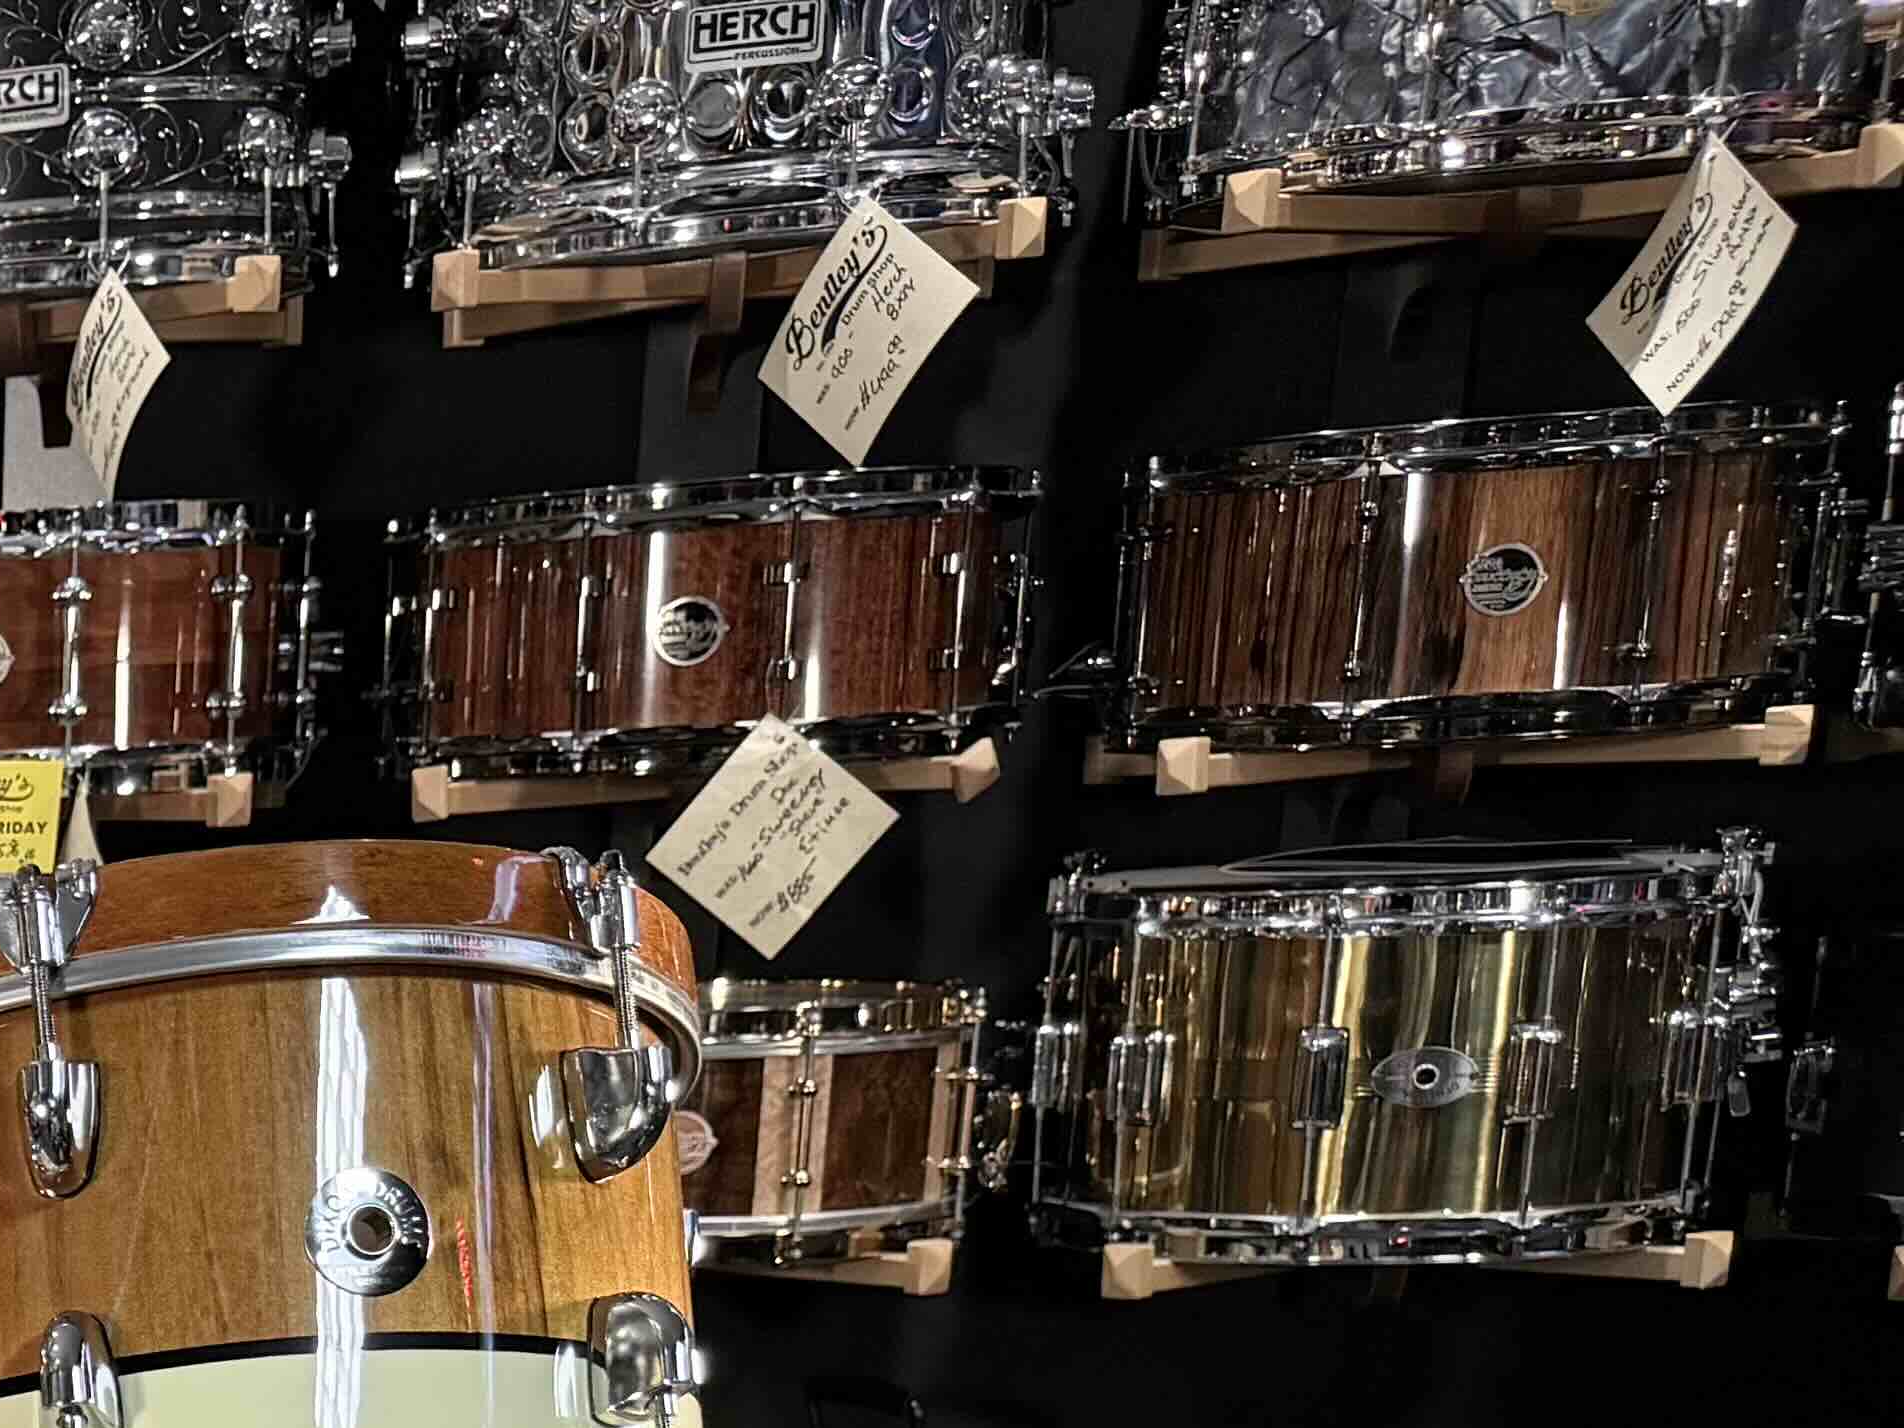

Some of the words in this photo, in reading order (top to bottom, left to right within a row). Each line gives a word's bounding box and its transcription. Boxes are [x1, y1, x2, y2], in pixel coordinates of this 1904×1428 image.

[693, 0, 812, 46] HERCH
[785, 224, 887, 370] Bentley's
[841, 290, 869, 326] Drum
[867, 252, 895, 288] Shop
[1620, 192, 1713, 325] Bentley's
